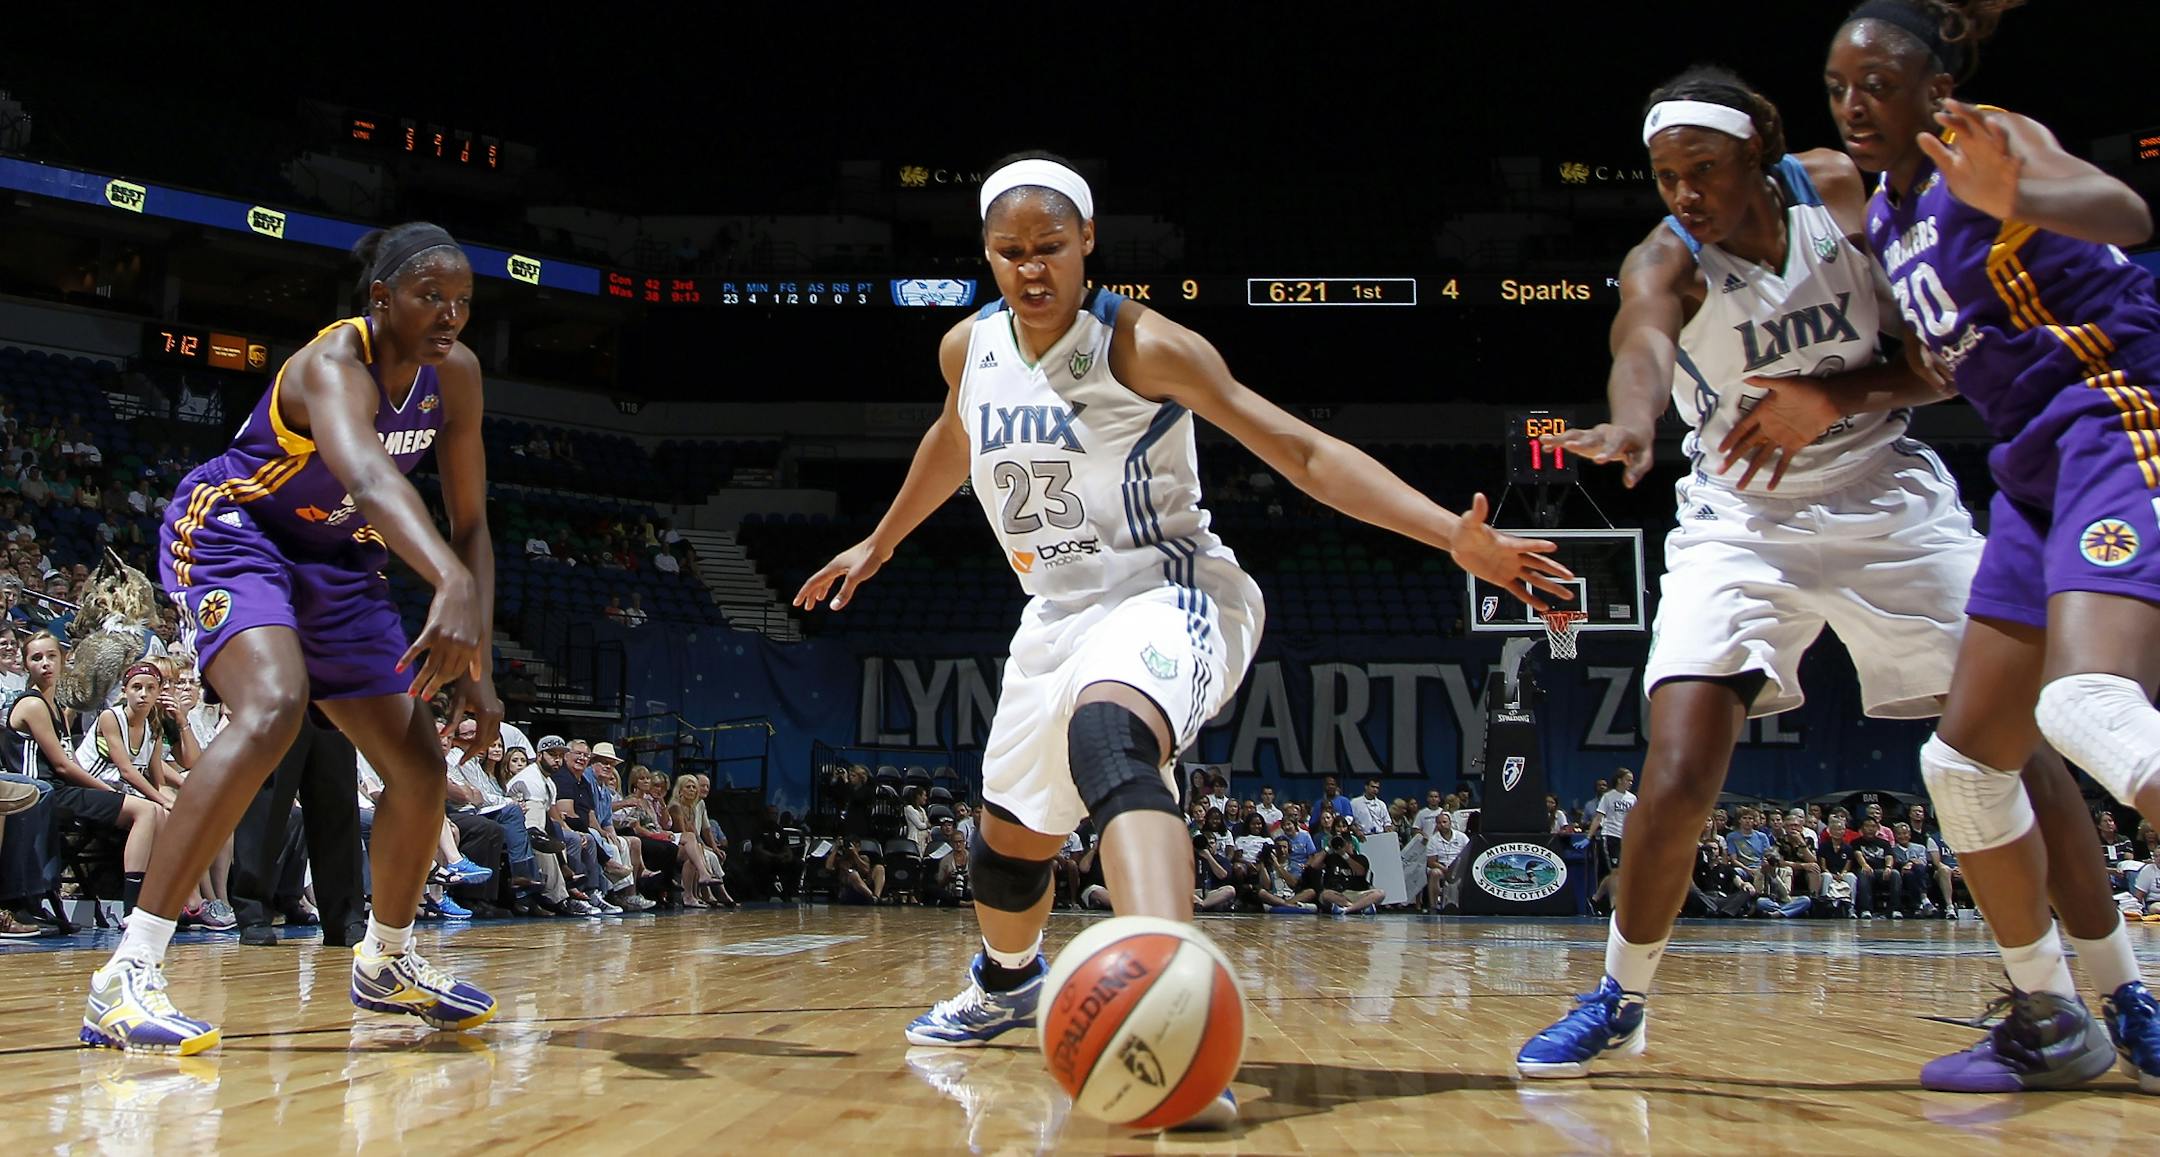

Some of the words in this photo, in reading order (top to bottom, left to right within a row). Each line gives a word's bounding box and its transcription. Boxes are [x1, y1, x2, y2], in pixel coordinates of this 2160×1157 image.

[111, 192, 138, 206] BUY
[112, 184, 145, 200] BEST
[253, 211, 285, 226] BEST
[253, 220, 281, 233] BUY
[512, 259, 540, 275] BEST
[512, 267, 535, 279] BUY
[609, 273, 632, 286] Con
[645, 279, 660, 290] 42
[672, 280, 693, 290] 3rd
[723, 283, 738, 292] PL
[747, 283, 768, 293] MIN
[780, 283, 796, 293] FG
[808, 283, 825, 293] AS
[832, 283, 849, 293] RB
[857, 283, 873, 292] PT
[609, 285, 633, 298] Was
[723, 294, 739, 304] 23
[749, 294, 757, 304] 4
[809, 294, 817, 304] 0
[834, 294, 842, 304] 0
[858, 294, 866, 304] 3
[1182, 279, 1198, 300] 9
[1269, 282, 1326, 302] 6:21
[1352, 285, 1382, 299] 1st
[1442, 279, 1460, 299] 4
[1501, 279, 1591, 305] Sparks
[1734, 292, 1860, 373] LYNX
[161, 332, 198, 356] 7:12
[979, 400, 1088, 455] LYNX
[1526, 418, 1566, 437] 6:20
[994, 460, 1085, 534] 23
[1037, 537, 1101, 561] boost
[1498, 714, 1530, 723] SPALDING
[1863, 793, 1879, 803] BAR
[1486, 844, 1553, 859] MINNESOTA
[1478, 878, 1508, 898] STATE
[1513, 880, 1561, 900] LOTTERY
